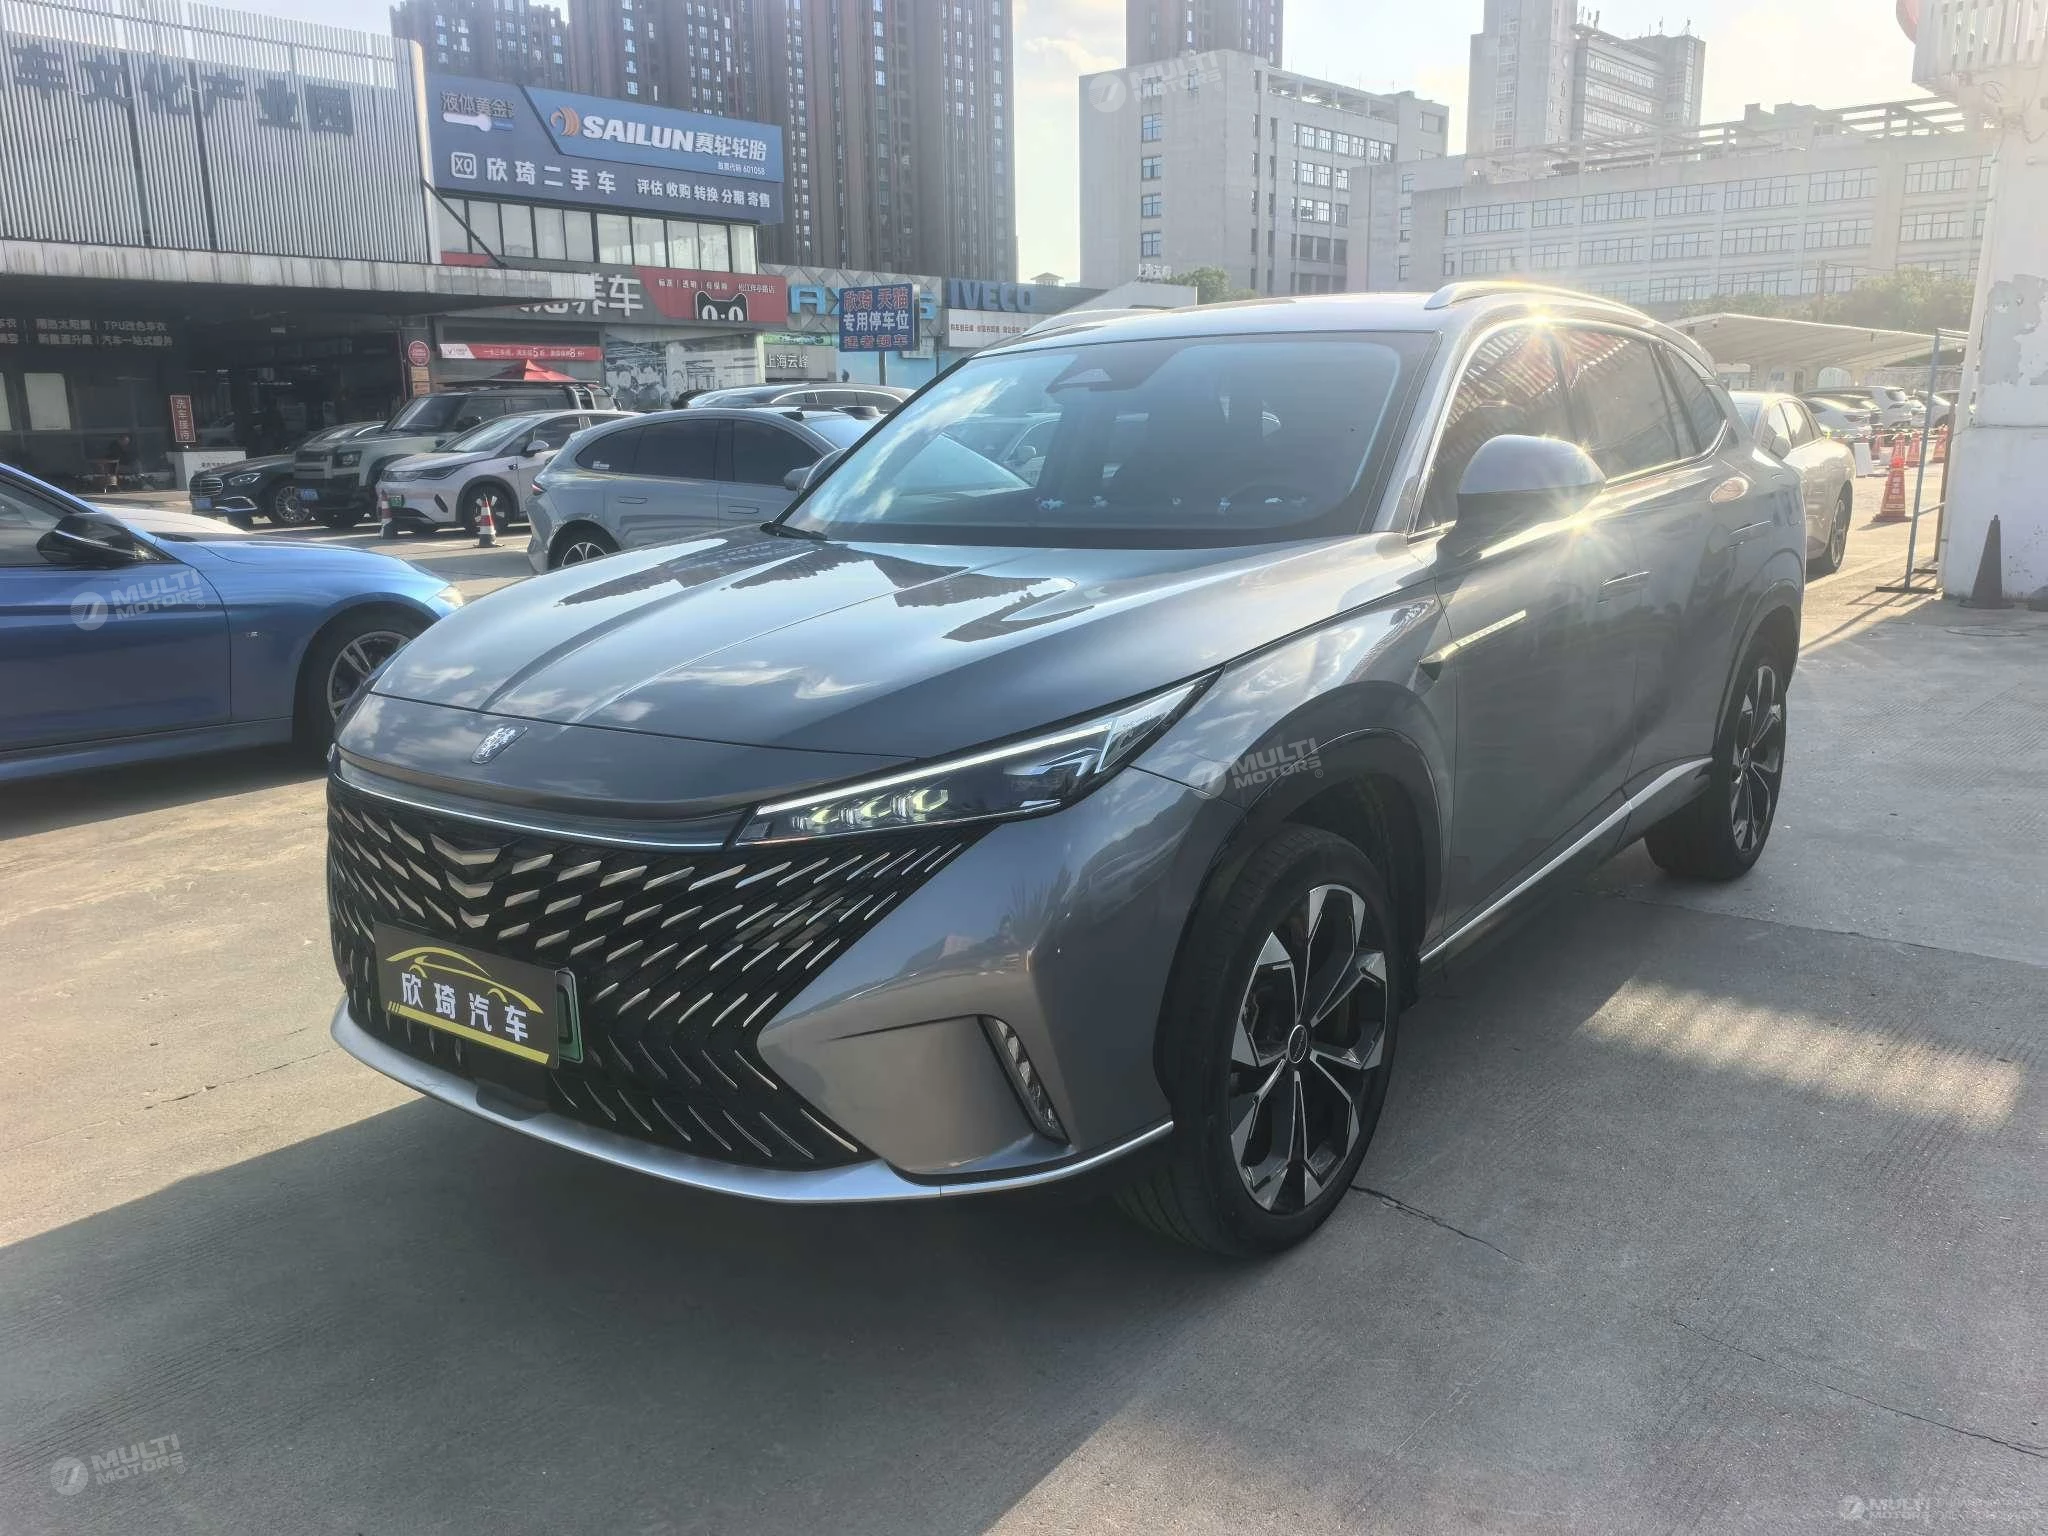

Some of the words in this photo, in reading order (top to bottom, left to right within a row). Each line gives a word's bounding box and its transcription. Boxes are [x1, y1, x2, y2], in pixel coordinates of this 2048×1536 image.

[583, 115, 694, 153] SAILUN
[695, 132, 767, 162] 赛轮轮胎
[486, 157, 617, 195] 欣琦二手车
[637, 178, 663, 196] 评估
[666, 181, 691, 199] 收购
[721, 188, 745, 206] 分期
[949, 279, 1034, 313] IVECO
[843, 311, 910, 332] 专用停车位
[401, 971, 529, 1042] 欣琦汽车
